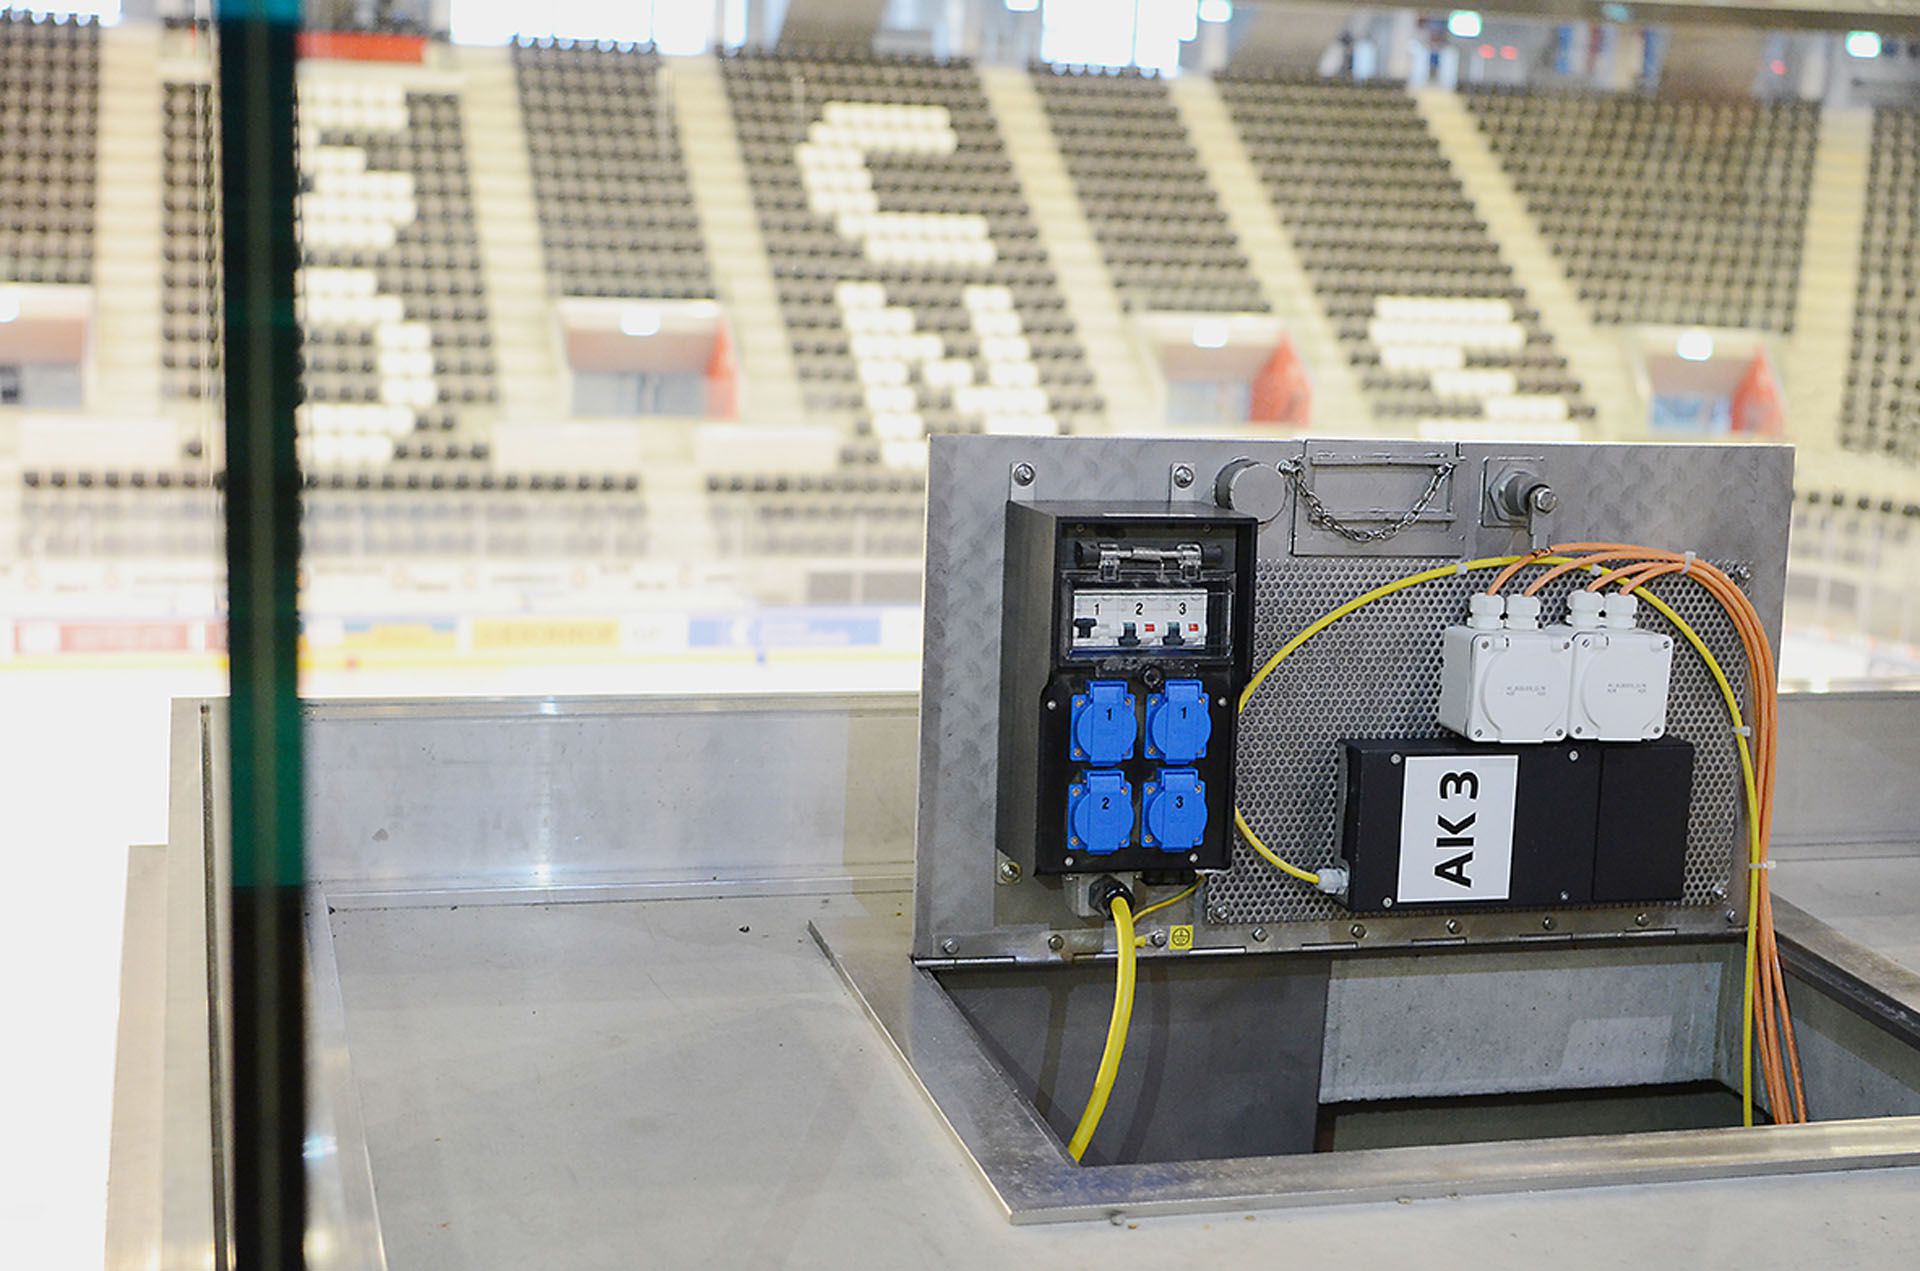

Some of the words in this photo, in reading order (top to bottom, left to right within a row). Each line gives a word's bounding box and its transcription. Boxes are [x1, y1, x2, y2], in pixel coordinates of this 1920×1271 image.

[1094, 603, 1100, 615] 1
[1135, 603, 1144, 616] 2
[1179, 603, 1187, 615] 3
[1105, 707, 1113, 720] 1
[1181, 706, 1188, 719] 1
[1440, 772, 1479, 800] 3
[1102, 797, 1110, 810] 2
[1175, 796, 1184, 809] 3
